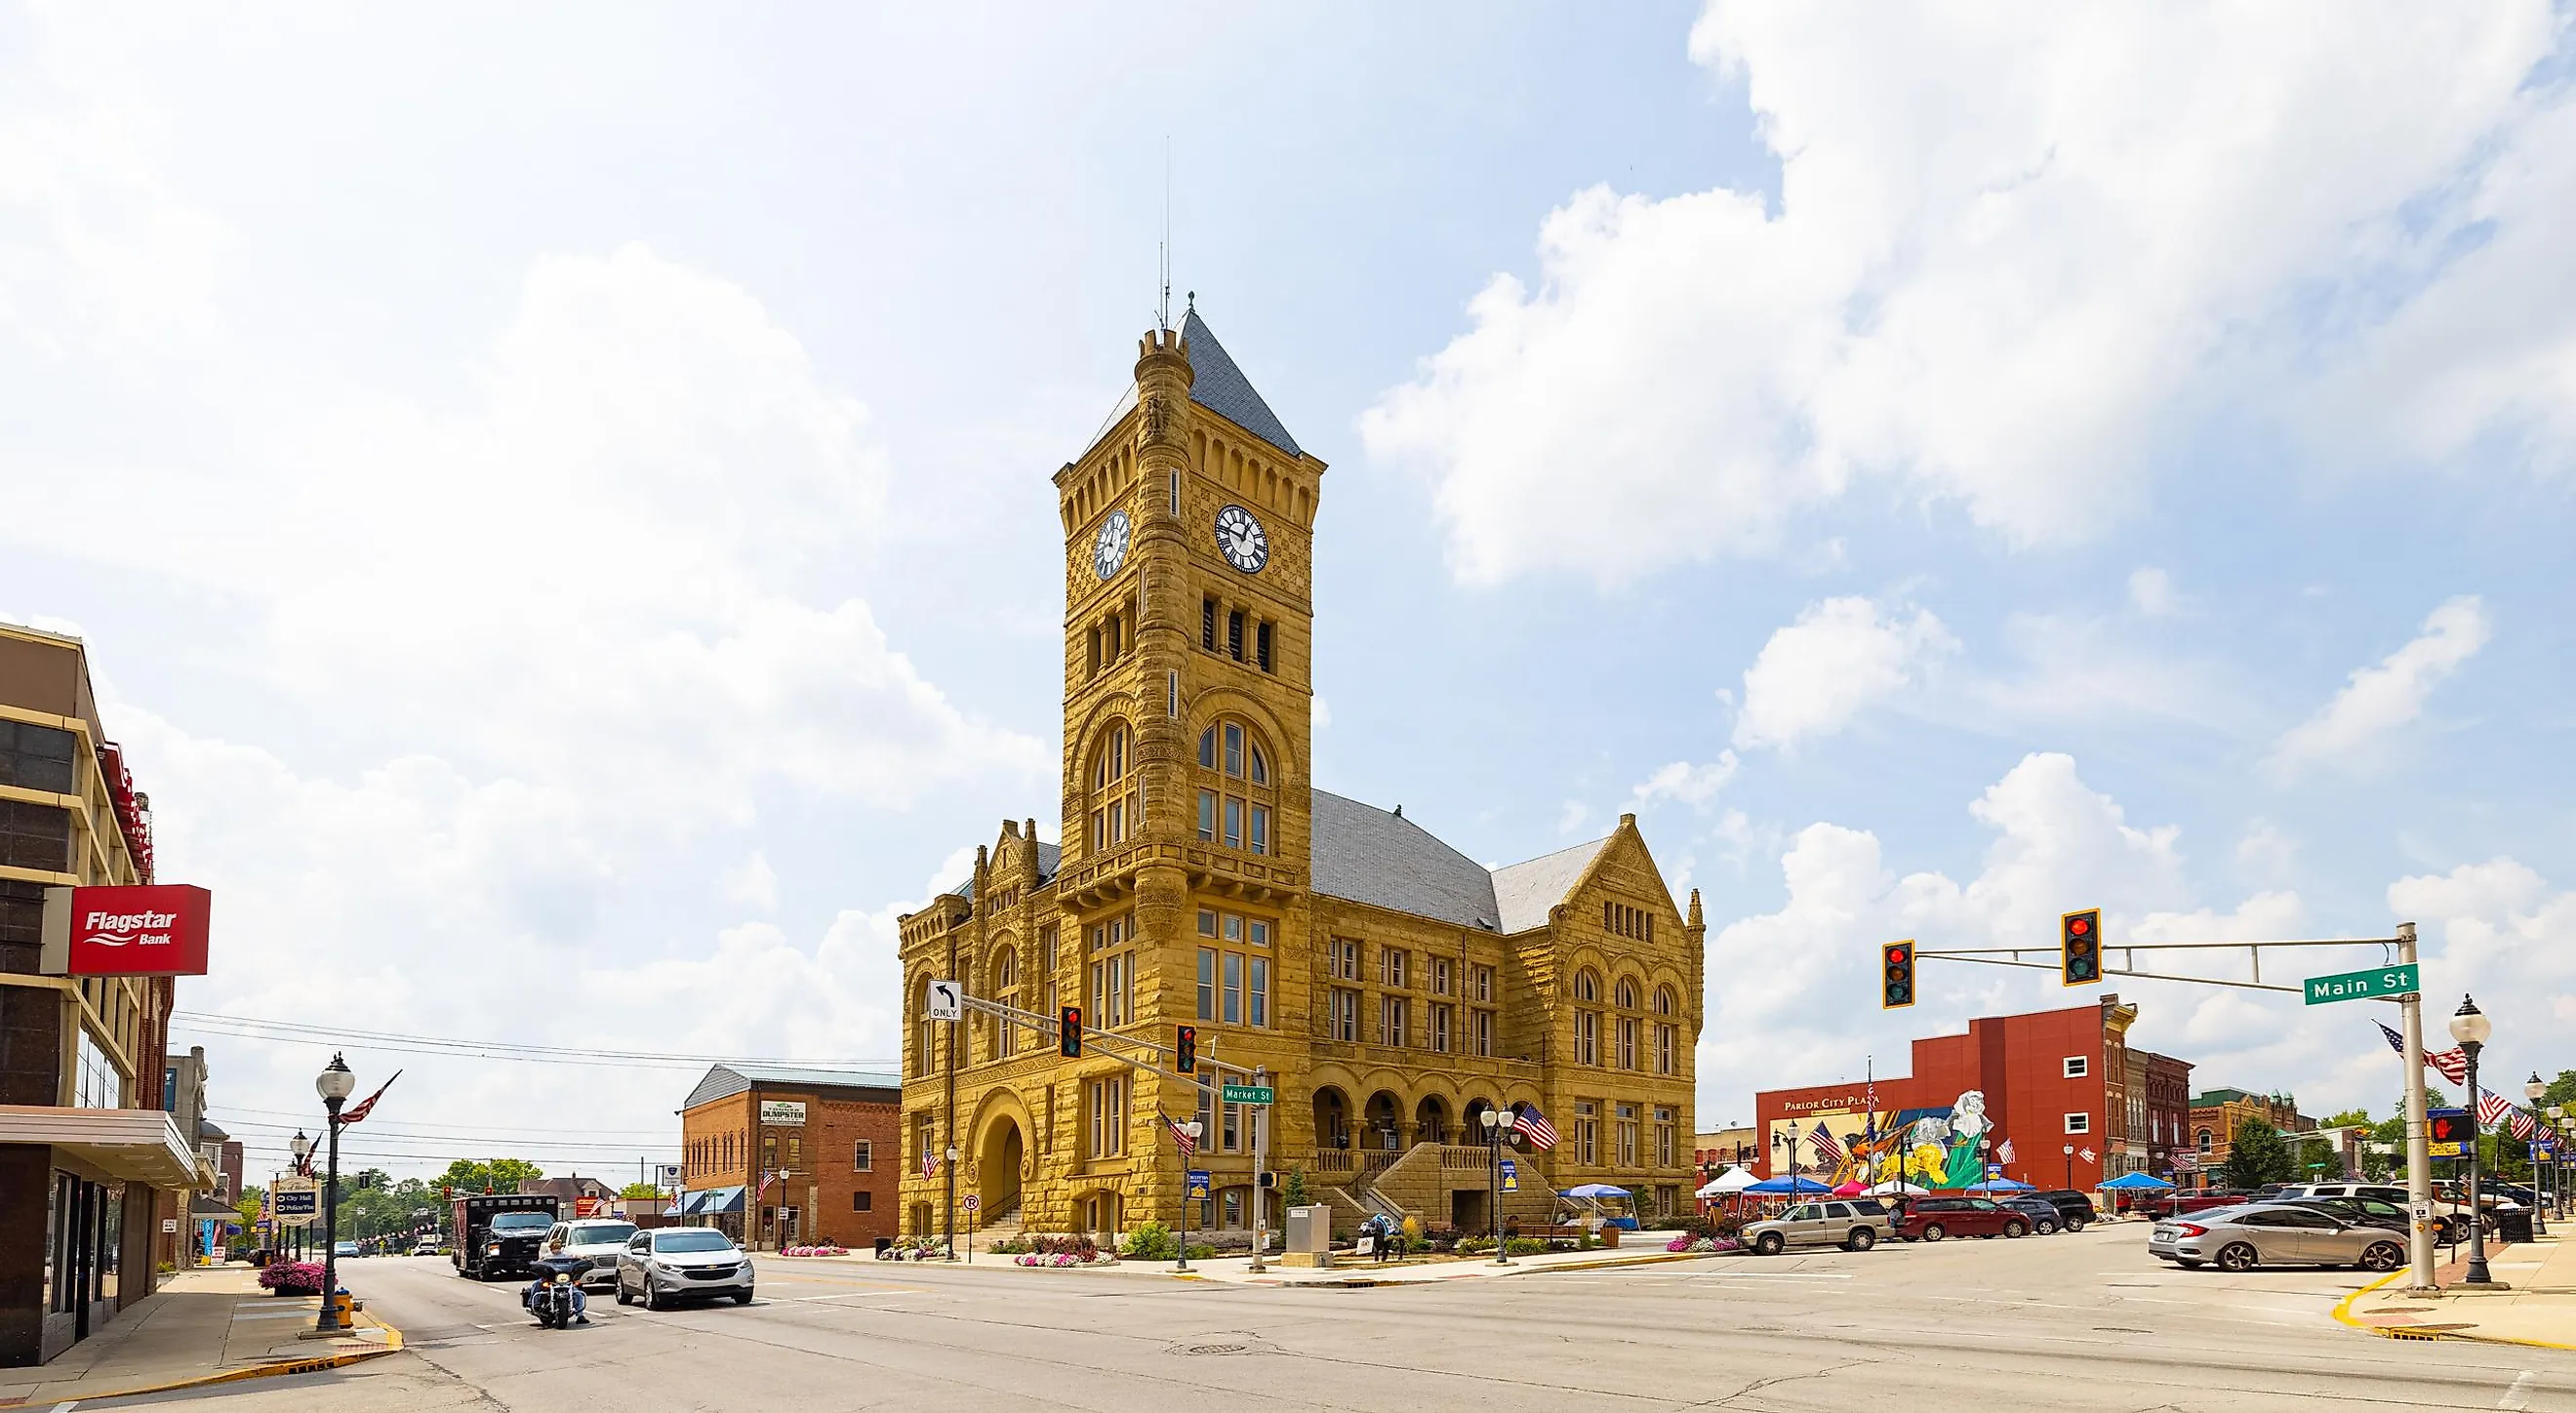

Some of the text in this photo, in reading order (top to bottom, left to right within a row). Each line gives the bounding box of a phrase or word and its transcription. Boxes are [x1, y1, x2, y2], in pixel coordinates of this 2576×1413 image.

[85, 909, 177, 933] Flagstar
[139, 933, 172, 946] Bank
[2314, 972, 2408, 998] Main St
[933, 1008, 956, 1017] ONLY
[1226, 1089, 1256, 1100] Market
[1785, 1101, 1819, 1111] PARLOR
[1821, 1098, 1845, 1109] CITY
[1847, 1096, 1880, 1107] PLAA
[762, 1110, 805, 1119] DUMPSTER
